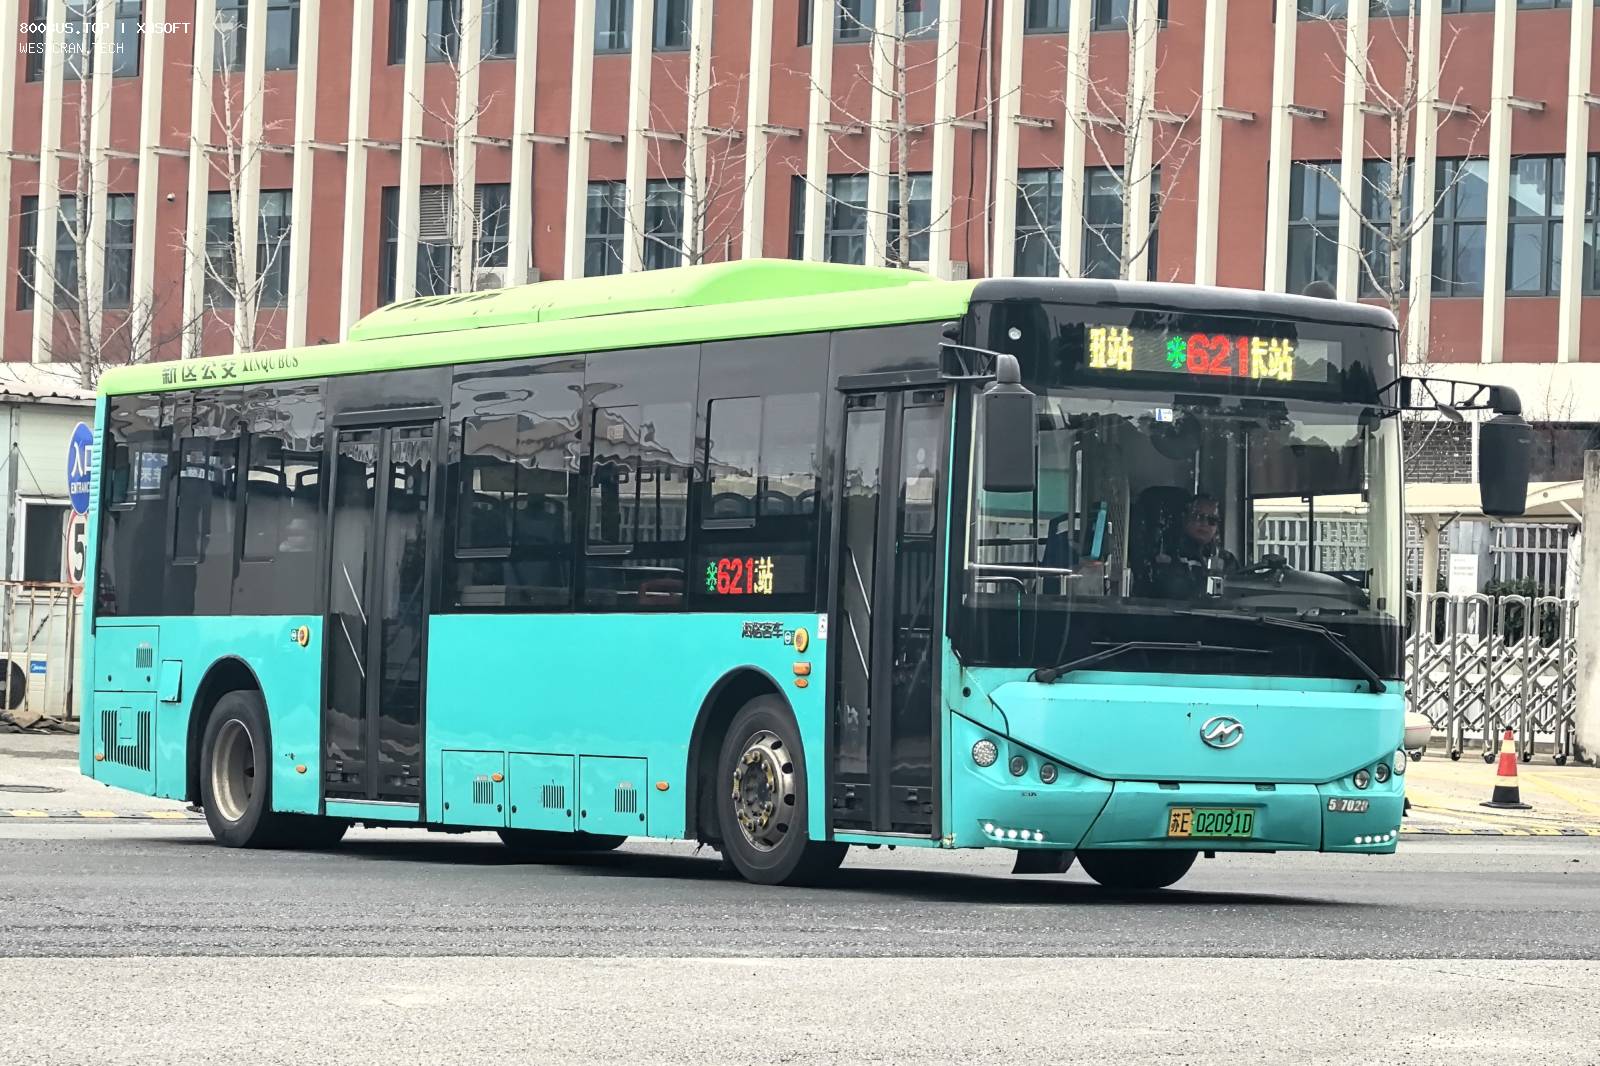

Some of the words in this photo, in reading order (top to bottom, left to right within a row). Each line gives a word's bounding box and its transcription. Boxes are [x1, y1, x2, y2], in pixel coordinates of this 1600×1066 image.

[1187, 332, 1249, 377] 621
[70, 481, 91, 494] ENTRANC
[717, 556, 754, 595] 621
[1170, 811, 1191, 833] 苏E
[1196, 812, 1252, 834] 02091D
